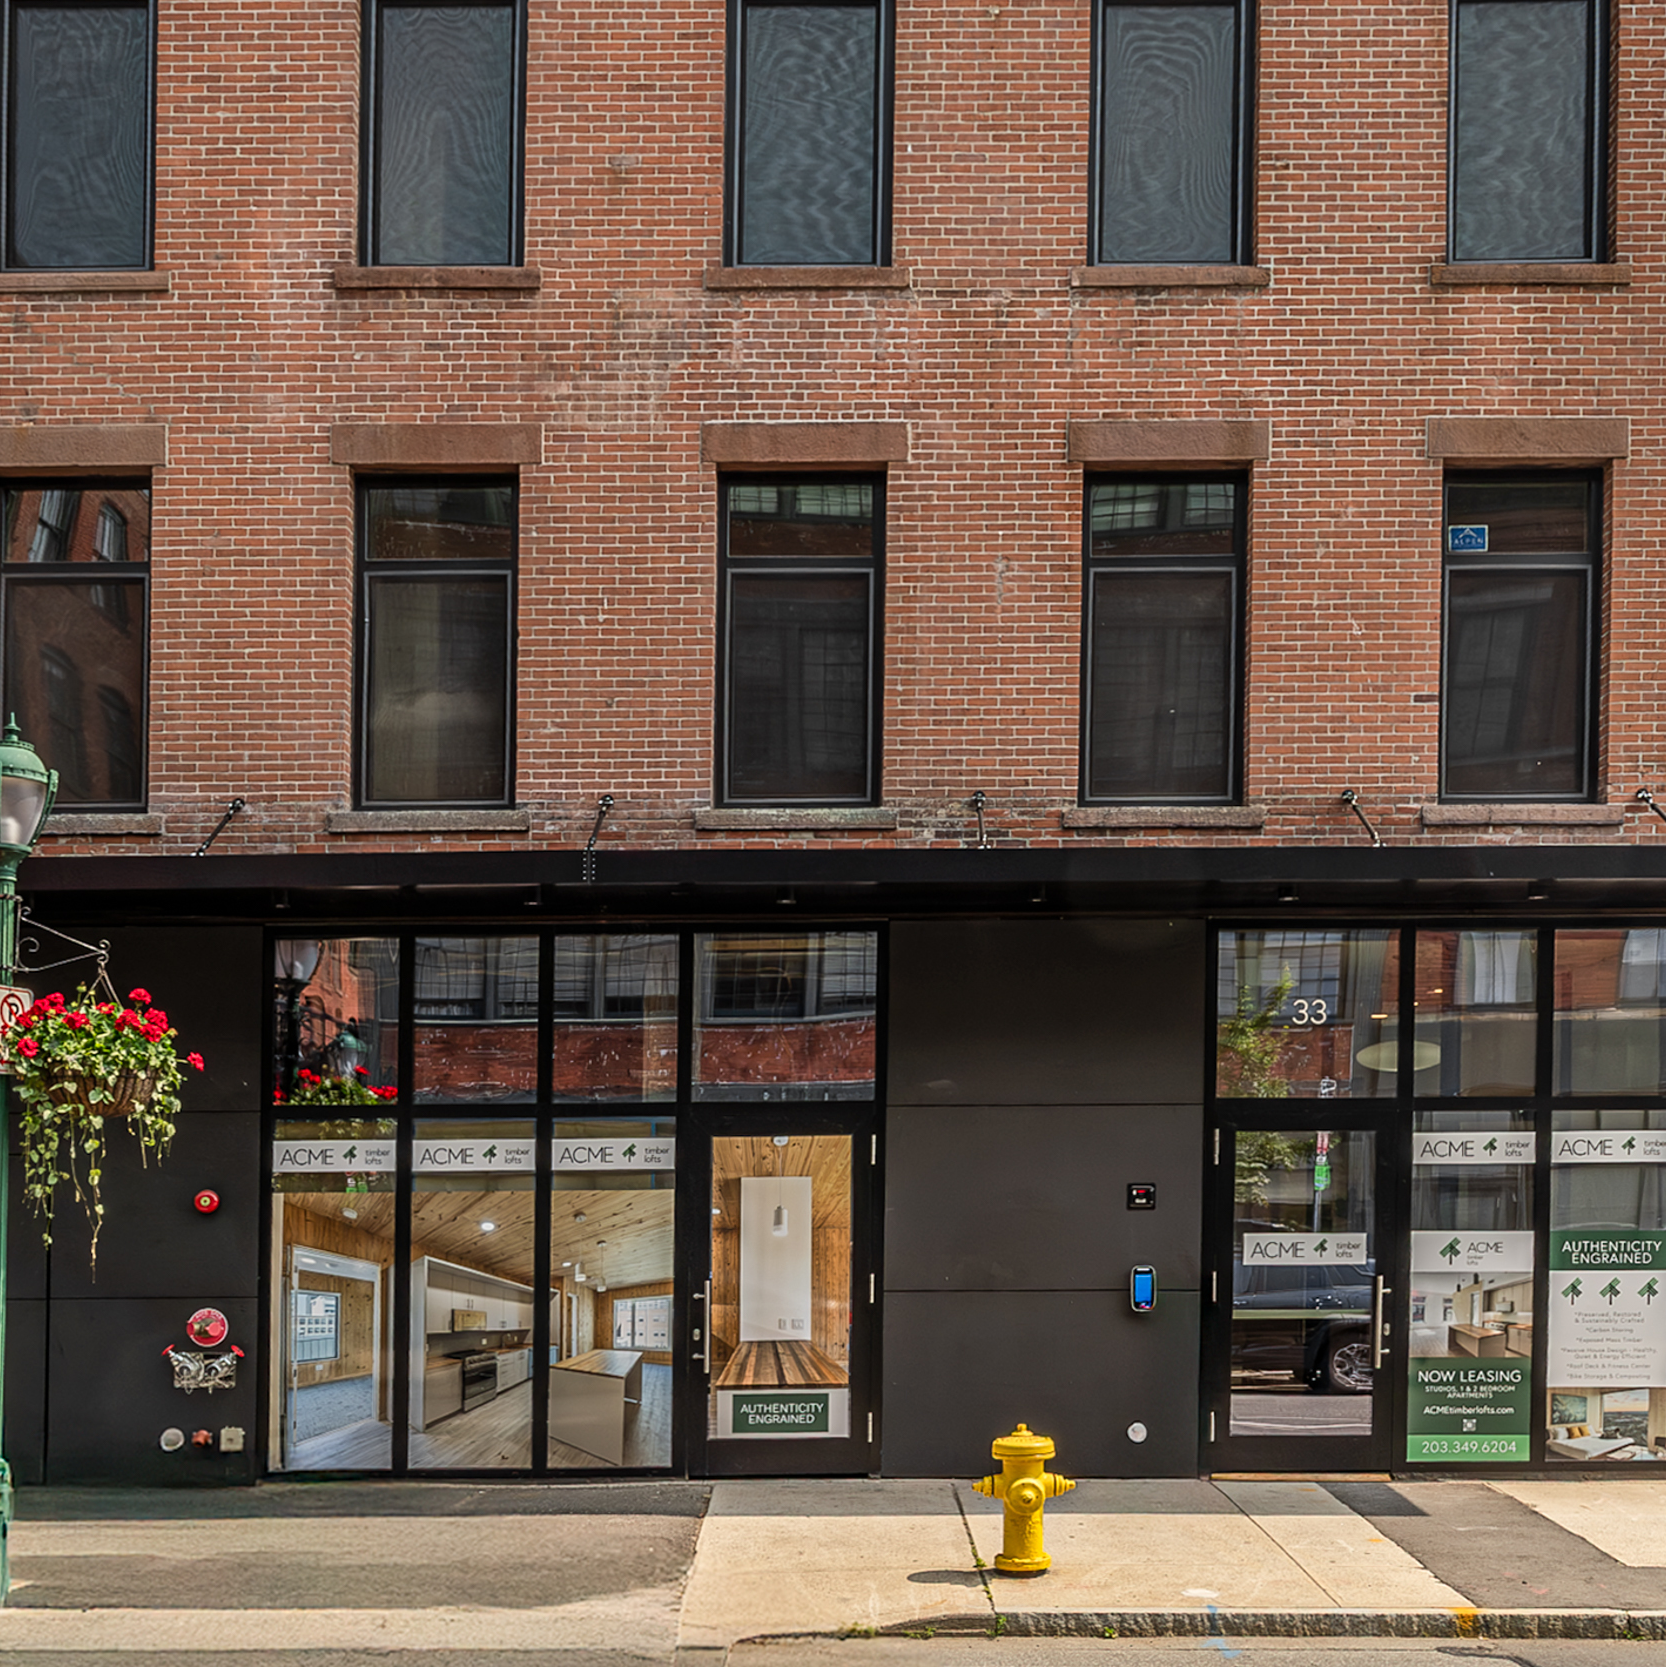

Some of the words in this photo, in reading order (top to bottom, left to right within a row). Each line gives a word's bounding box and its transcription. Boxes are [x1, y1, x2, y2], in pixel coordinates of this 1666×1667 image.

[8, 1002, 19, 1022] P
[1292, 999, 1327, 1025] 33
[1420, 1140, 1475, 1158] ACME
[1505, 1140, 1530, 1149] timber
[1558, 1139, 1613, 1156] ACME
[365, 1147, 390, 1157] timber
[419, 1147, 474, 1165] ACME
[505, 1147, 530, 1156] timber
[559, 1146, 614, 1164] ACME
[644, 1146, 670, 1155] timber
[1505, 1149, 1522, 1157] lofts
[279, 1148, 334, 1166] ACME
[365, 1157, 382, 1165] lofts
[504, 1156, 522, 1164] lofts
[644, 1155, 662, 1163] lofts
[1250, 1241, 1305, 1259] ACME
[1336, 1241, 1361, 1249] timber
[1466, 1241, 1504, 1253] ACME
[1561, 1240, 1662, 1252] AUTHENTICITY
[1335, 1250, 1353, 1258] lofts
[1571, 1252, 1653, 1264] ENGRAINED
[1417, 1370, 1456, 1383] NOW
[1459, 1369, 1522, 1383] LEASING
[1479, 1384, 1516, 1392] BEDROOM
[740, 1402, 824, 1413] AUTHENTICITY
[1423, 1405, 1515, 1415] ACMEtimberlofts.com
[748, 1414, 815, 1425] ENGRAINED
[1421, 1440, 1517, 1454] 203.349.6204
